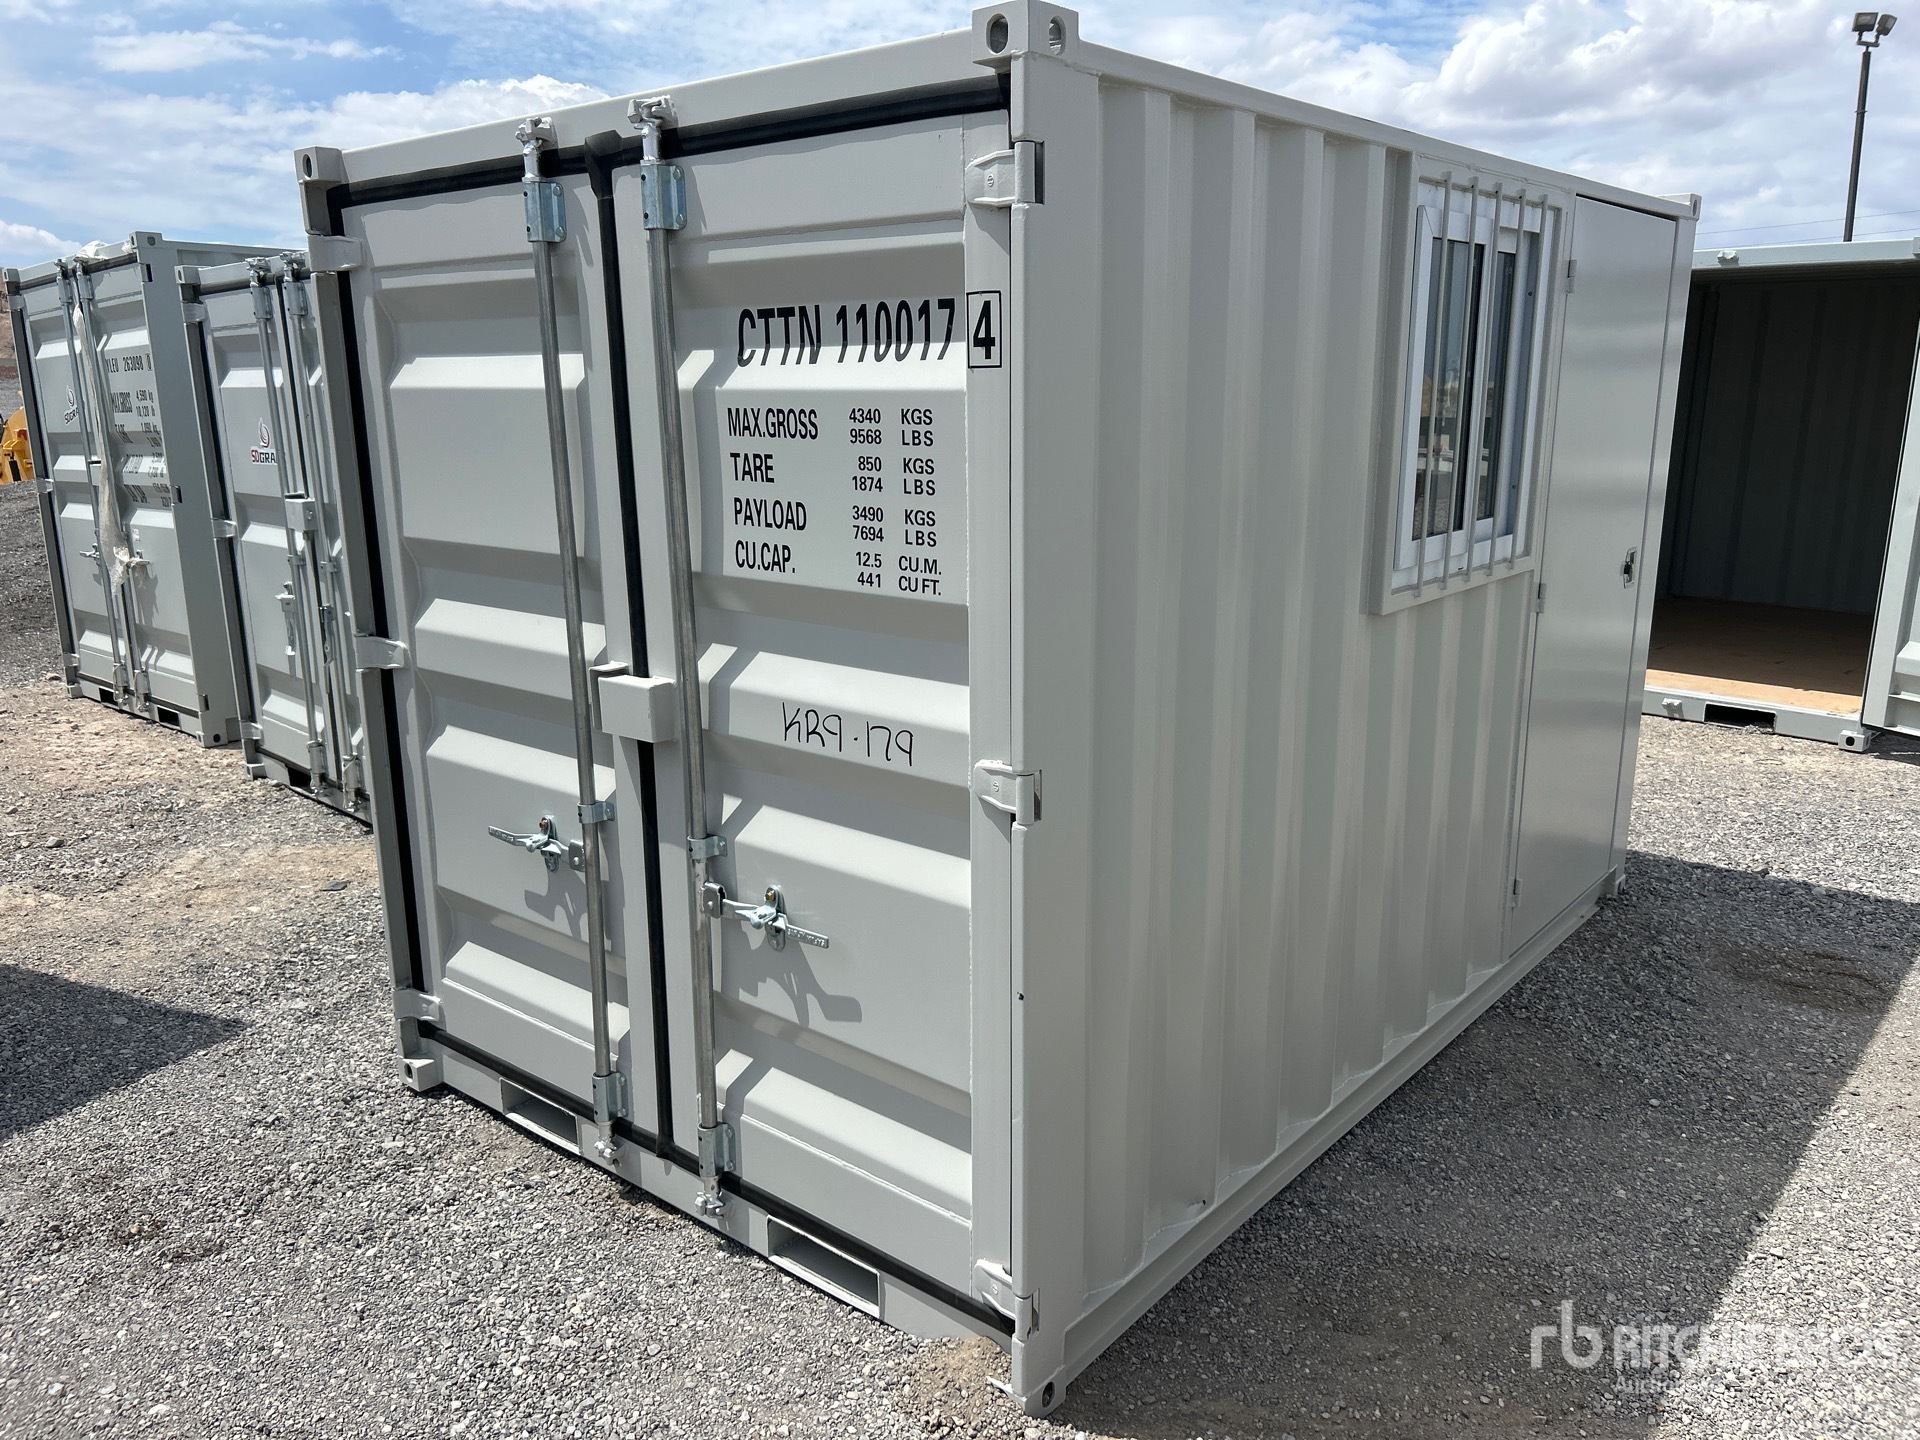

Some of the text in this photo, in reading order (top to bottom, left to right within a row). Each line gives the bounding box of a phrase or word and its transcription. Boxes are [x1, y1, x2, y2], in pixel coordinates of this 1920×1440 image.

[737, 298, 996, 367] CTTN 110017 4
[727, 407, 934, 440] MAX.GROSS 4340 KGS
[849, 429, 934, 447] 9568 LBS
[730, 452, 935, 483] TARE 850 KGS
[852, 476, 936, 496] 1874 LBS
[733, 497, 936, 531] PAYLOAD 3490 KGS
[852, 525, 937, 548] 7694 LBS
[735, 540, 942, 576] CU.CAP. 12.5 CU.M.
[857, 572, 882, 588] 441
